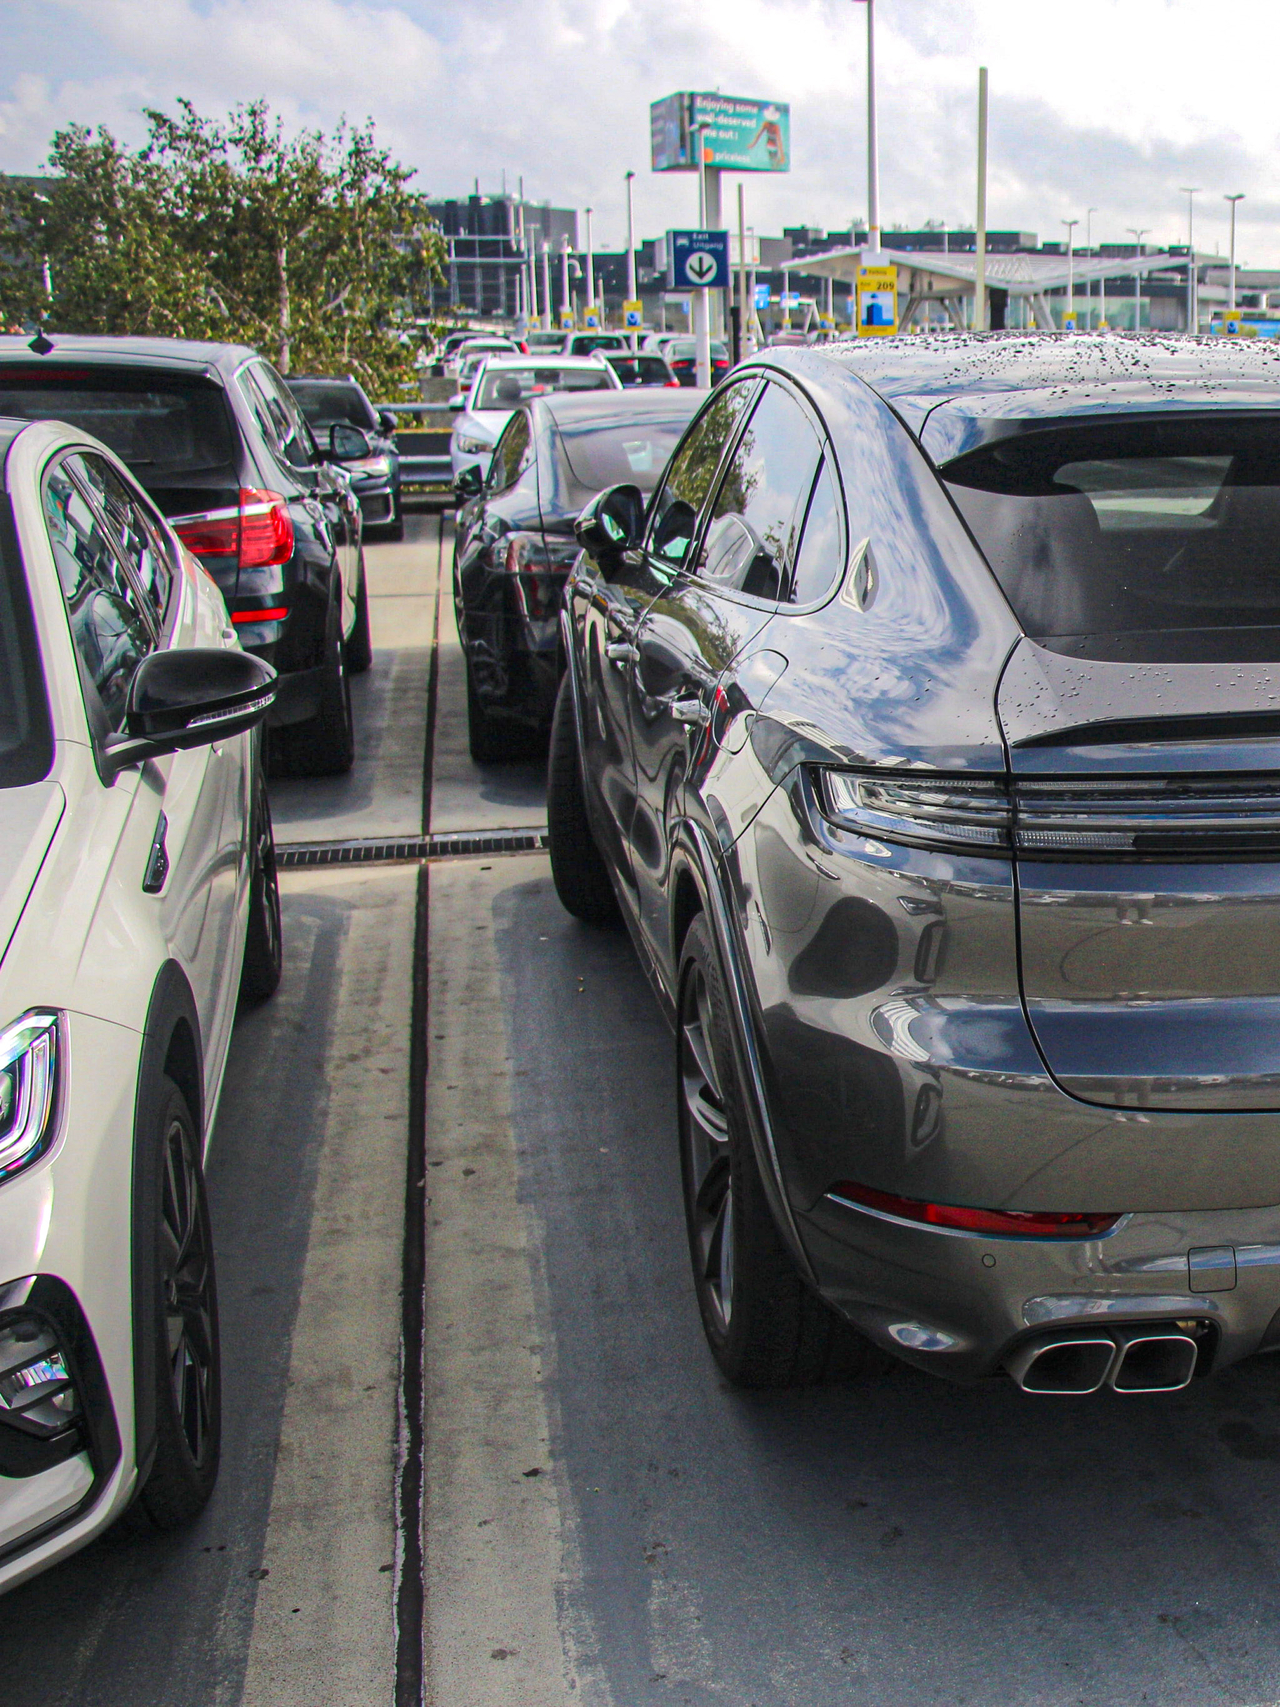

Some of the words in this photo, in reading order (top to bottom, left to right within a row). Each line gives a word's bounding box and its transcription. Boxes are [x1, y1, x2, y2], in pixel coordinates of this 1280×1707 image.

[696, 96, 734, 113] Enjoying
[735, 103, 758, 113] some
[693, 242, 724, 251] Uitgang
[876, 281, 895, 291] 209
